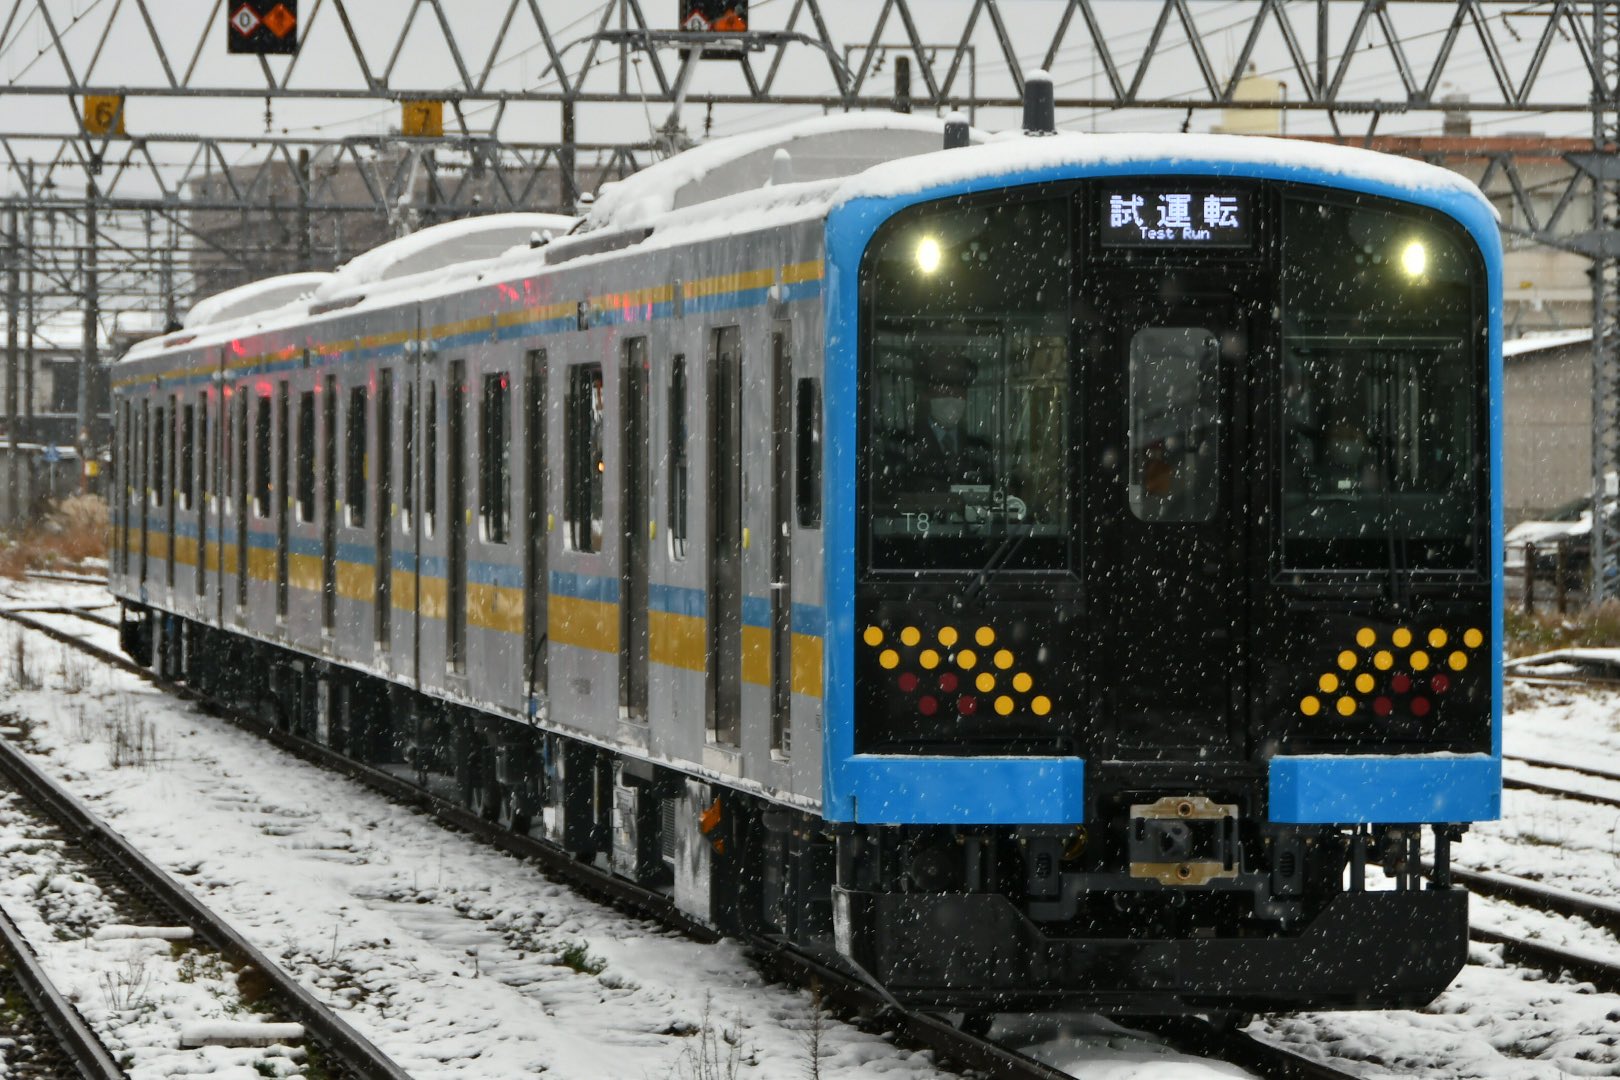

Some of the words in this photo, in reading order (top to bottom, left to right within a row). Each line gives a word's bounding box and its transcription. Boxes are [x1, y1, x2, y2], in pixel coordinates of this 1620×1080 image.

[96, 102, 113, 129] 6
[417, 107, 430, 136] 7
[1110, 194, 1239, 228] 試運転
[1139, 226, 1176, 240] Test
[1182, 226, 1211, 240] Run
[901, 512, 930, 532] T8
